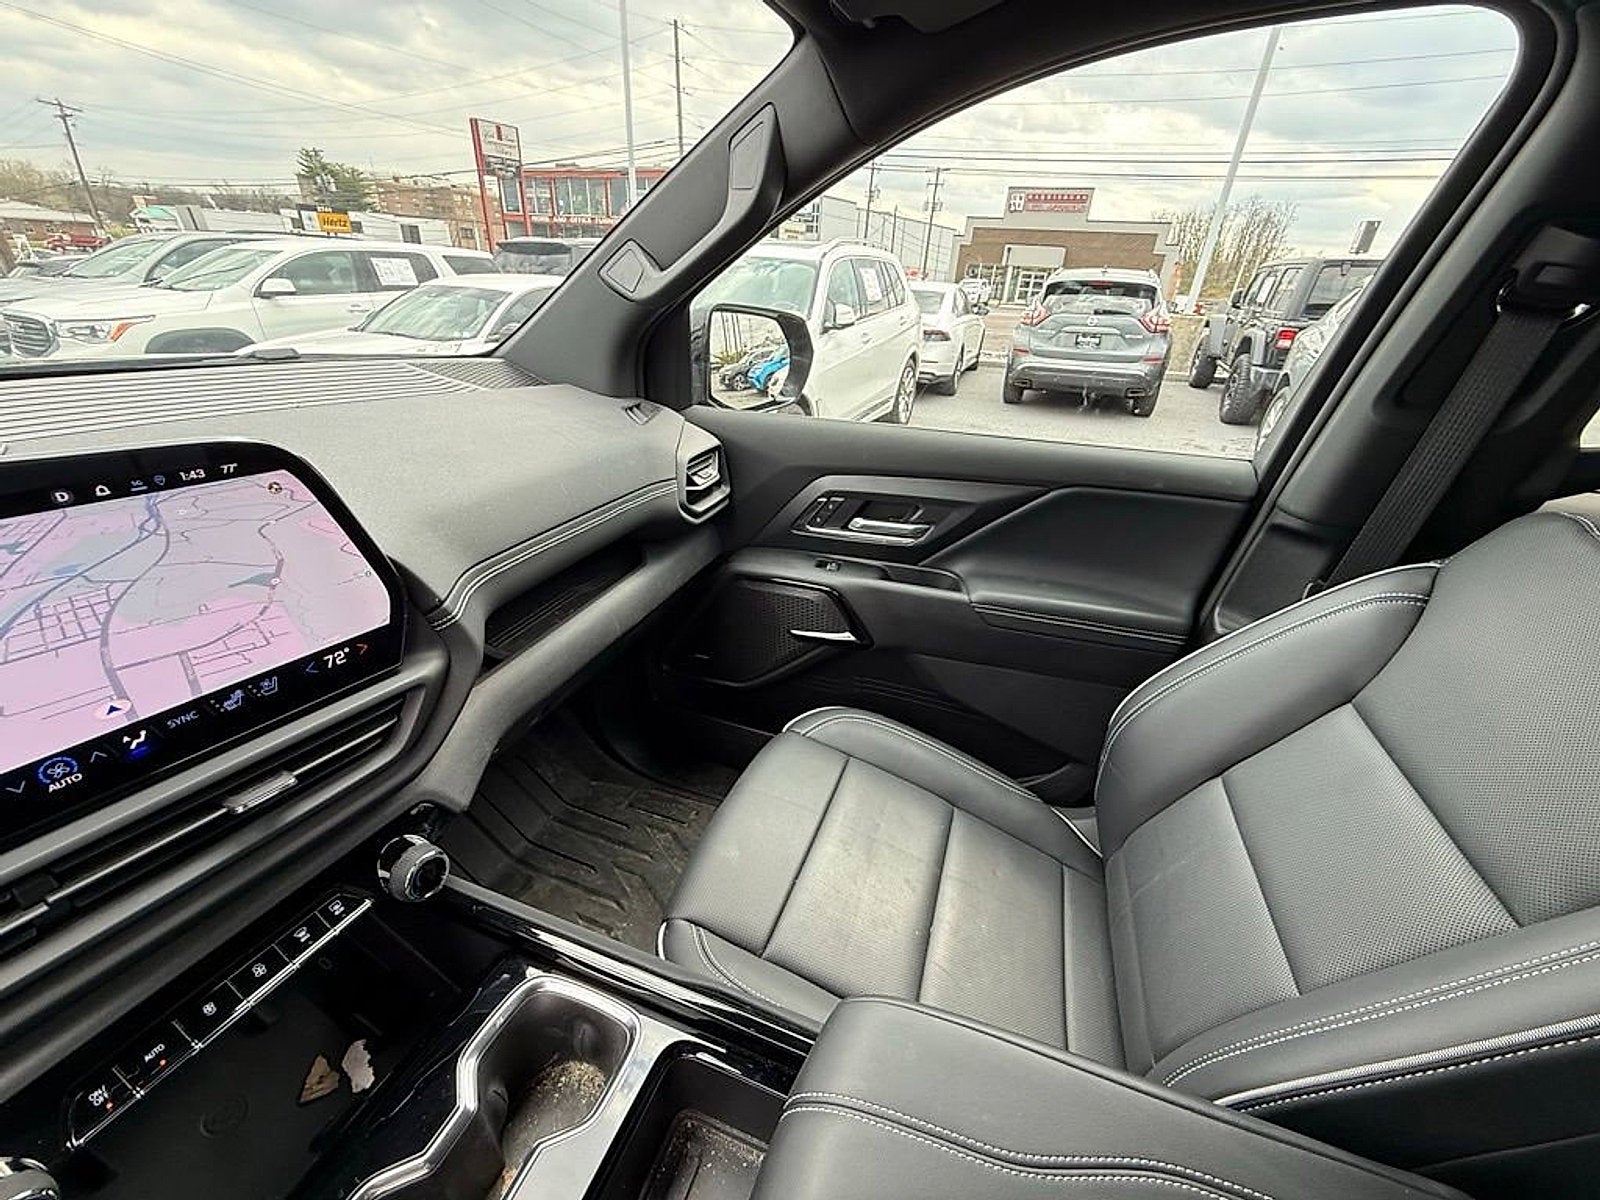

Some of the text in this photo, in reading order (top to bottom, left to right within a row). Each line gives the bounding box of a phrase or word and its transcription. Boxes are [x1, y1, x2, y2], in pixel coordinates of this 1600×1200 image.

[322, 217, 348, 228] Hertz
[179, 468, 206, 481] 1:43
[323, 646, 351, 669] 72°
[166, 710, 200, 730] SYNC
[48, 772, 83, 793] AUTO
[144, 1043, 166, 1063] AUTO
